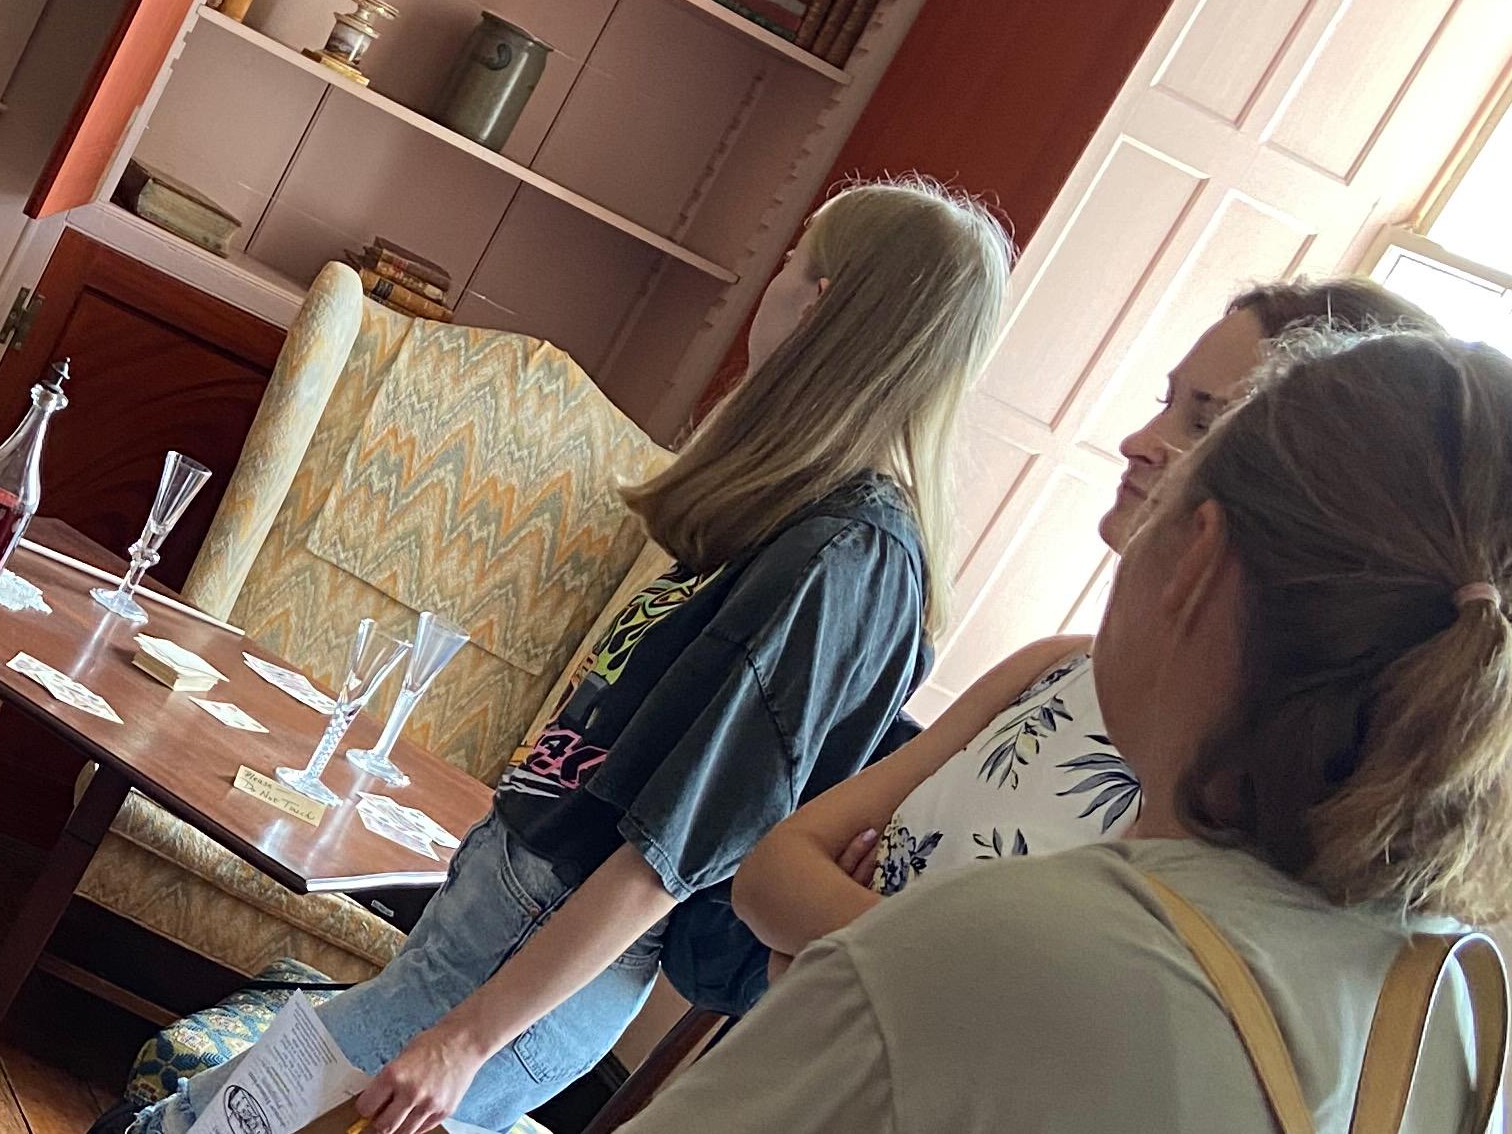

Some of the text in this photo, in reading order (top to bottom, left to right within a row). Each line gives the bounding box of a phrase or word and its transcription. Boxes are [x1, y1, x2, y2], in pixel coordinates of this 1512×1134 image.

[244, 769, 273, 789] Please
[241, 777, 257, 792] Do
[281, 797, 316, 820] Touch
